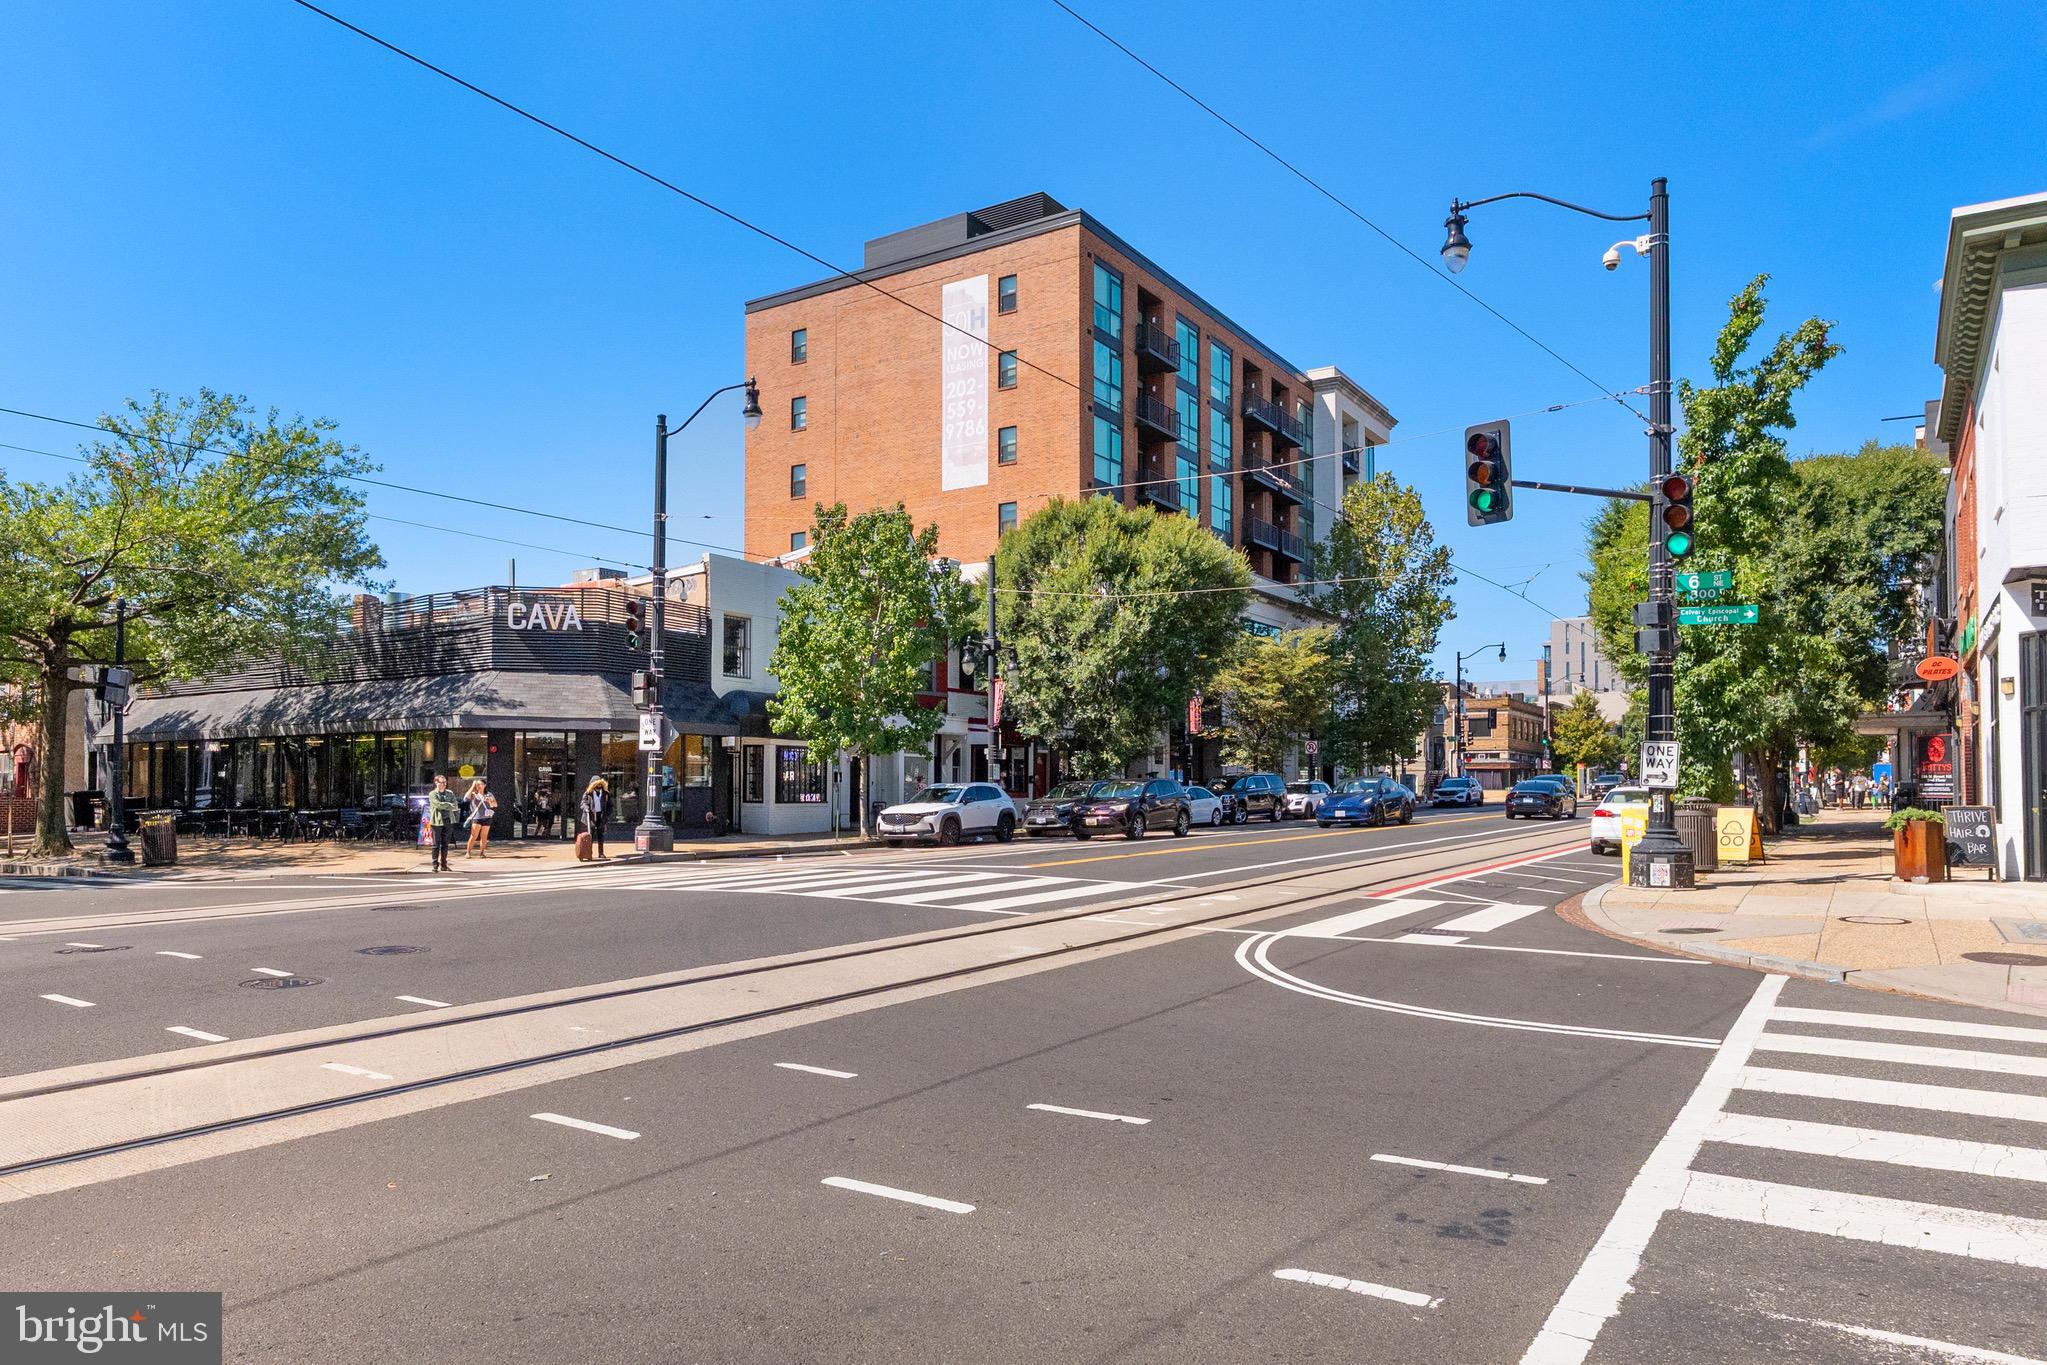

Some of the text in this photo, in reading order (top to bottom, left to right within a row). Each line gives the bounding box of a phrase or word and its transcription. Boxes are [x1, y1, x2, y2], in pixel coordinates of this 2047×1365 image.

[947, 342, 983, 363] NOW
[946, 358, 984, 374] LEASING
[947, 377, 984, 399] 202-
[947, 398, 983, 420] 559-
[945, 418, 985, 441] 9786
[1688, 575, 1700, 589] 6
[508, 602, 583, 631] CAVA
[1707, 607, 1740, 616] Episcopal
[1696, 615, 1729, 623] Church
[644, 718, 657, 726] ONE
[1646, 745, 1674, 756] ONE
[1645, 757, 1675, 769] WAY
[1948, 810, 1988, 823] THRIVE
[1949, 826, 1975, 839] HAIR
[1967, 841, 1988, 854] BAR
